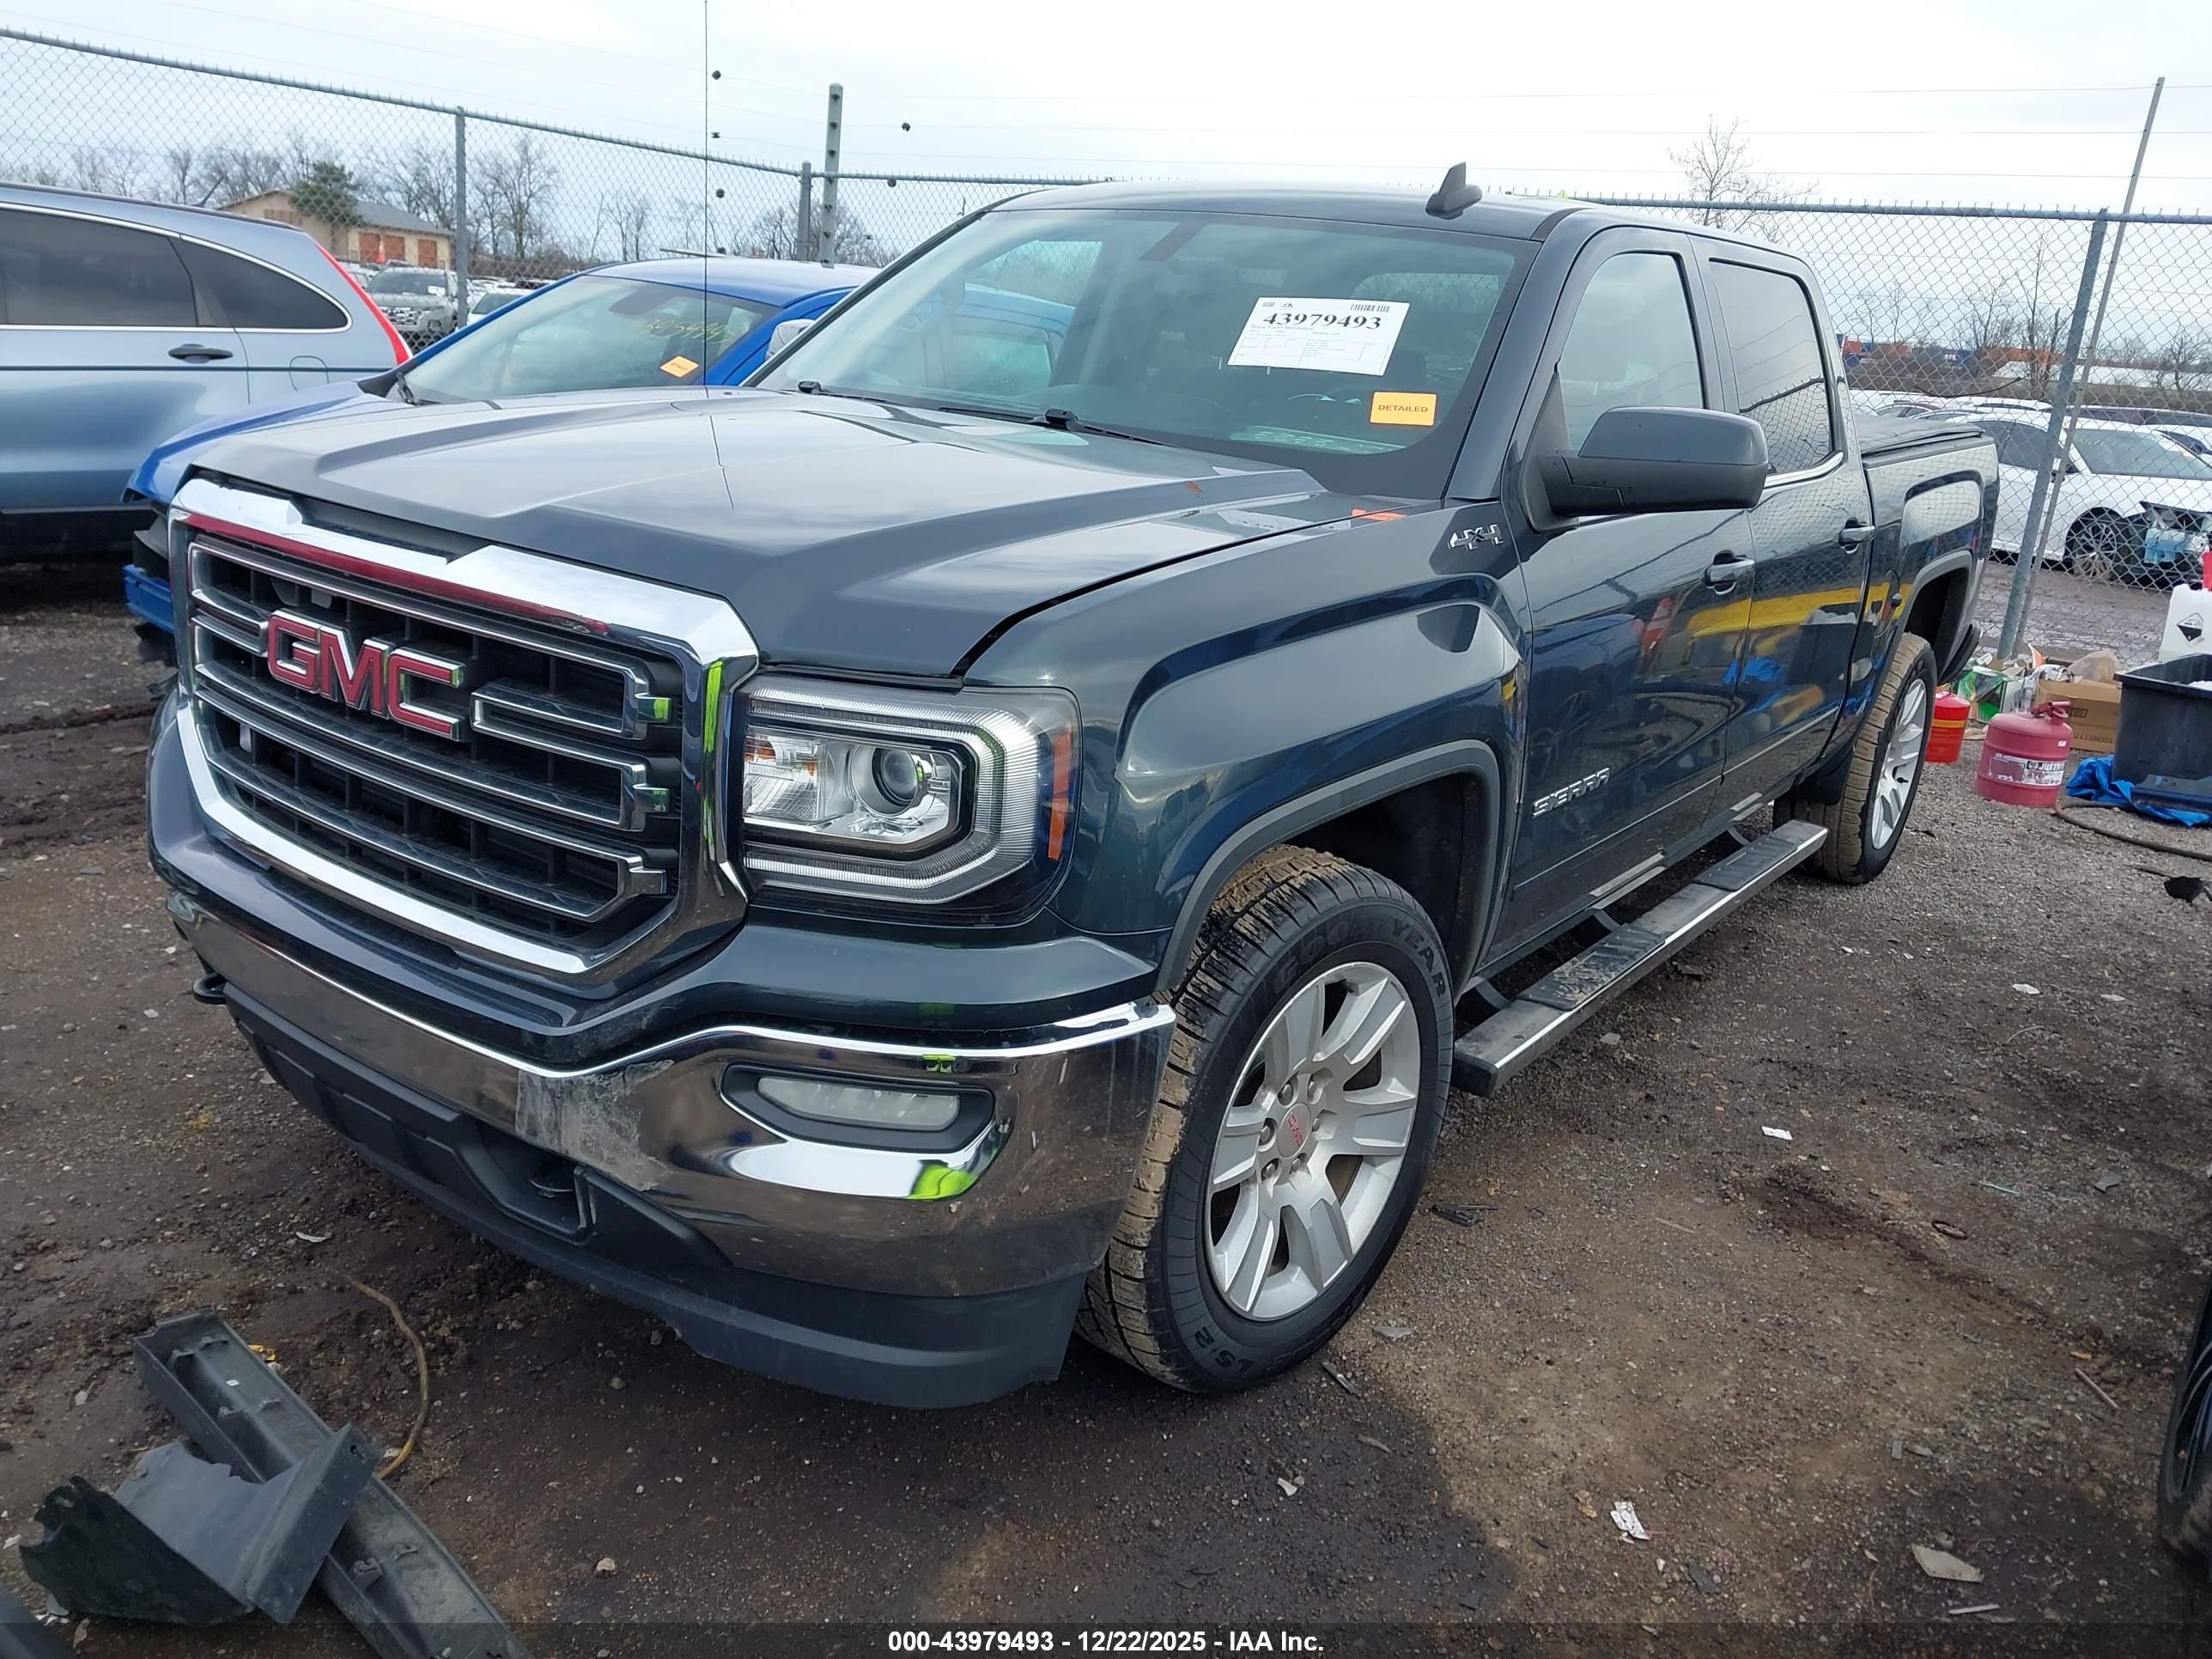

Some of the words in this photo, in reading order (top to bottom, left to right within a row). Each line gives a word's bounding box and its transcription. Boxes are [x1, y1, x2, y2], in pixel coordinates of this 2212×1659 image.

[1263, 313, 1381, 329] 43979493
[1378, 404, 1428, 413] DETAILED
[267, 609, 466, 742] GMC
[1533, 767, 1610, 817] SIERRA
[1286, 1112, 1304, 1147] GMC
